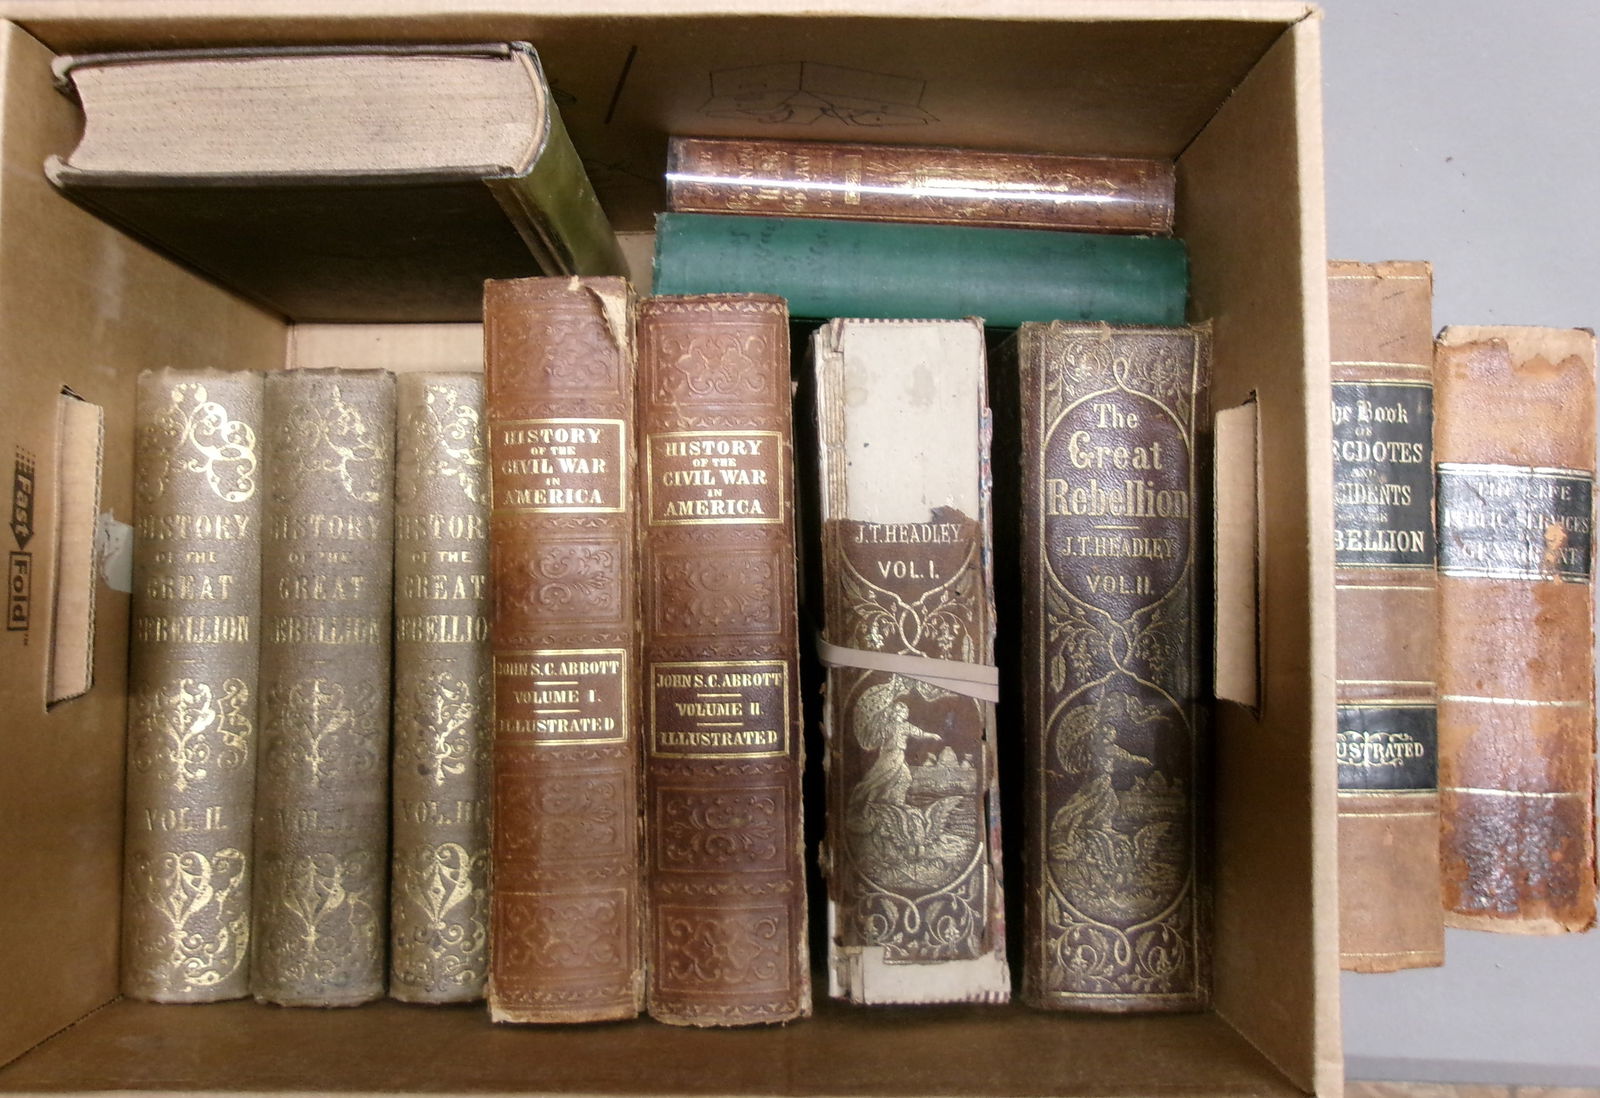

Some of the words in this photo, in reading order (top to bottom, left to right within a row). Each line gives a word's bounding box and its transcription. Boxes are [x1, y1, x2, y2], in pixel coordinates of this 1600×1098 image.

[1094, 404, 1139, 429] The
[1356, 400, 1409, 424] Book
[504, 428, 601, 446] HISTORY
[530, 446, 547, 456] OF
[550, 446, 577, 456] THE
[664, 440, 763, 457] HISTORY
[1069, 431, 1163, 470] Great
[502, 458, 554, 475] CIVIL
[556, 458, 607, 474] WAR
[692, 458, 709, 468] OF
[711, 457, 737, 468] THE
[546, 477, 561, 486] IN
[662, 469, 716, 487] CIVIL
[719, 469, 768, 486] WAR
[503, 488, 605, 505] AMERICA
[706, 488, 723, 498] IN
[1046, 478, 1188, 518] Rebellion
[1334, 482, 1412, 506] CIDENTS
[15, 474, 32, 537] Fast
[663, 499, 765, 517] AMERICA
[138, 514, 250, 540] HISTORY
[397, 514, 484, 541] HISTOR
[1334, 530, 1424, 553] BELLION
[438, 551, 473, 563] THE
[12, 559, 28, 622] Fold
[146, 575, 233, 600] GREAT
[513, 690, 580, 705] VOLUME
[675, 702, 743, 717] VOLUME
[500, 716, 615, 734] ILLUSTRATED
[660, 730, 778, 746] ILLUSTRATED
[1336, 742, 1424, 759] USTRATED
